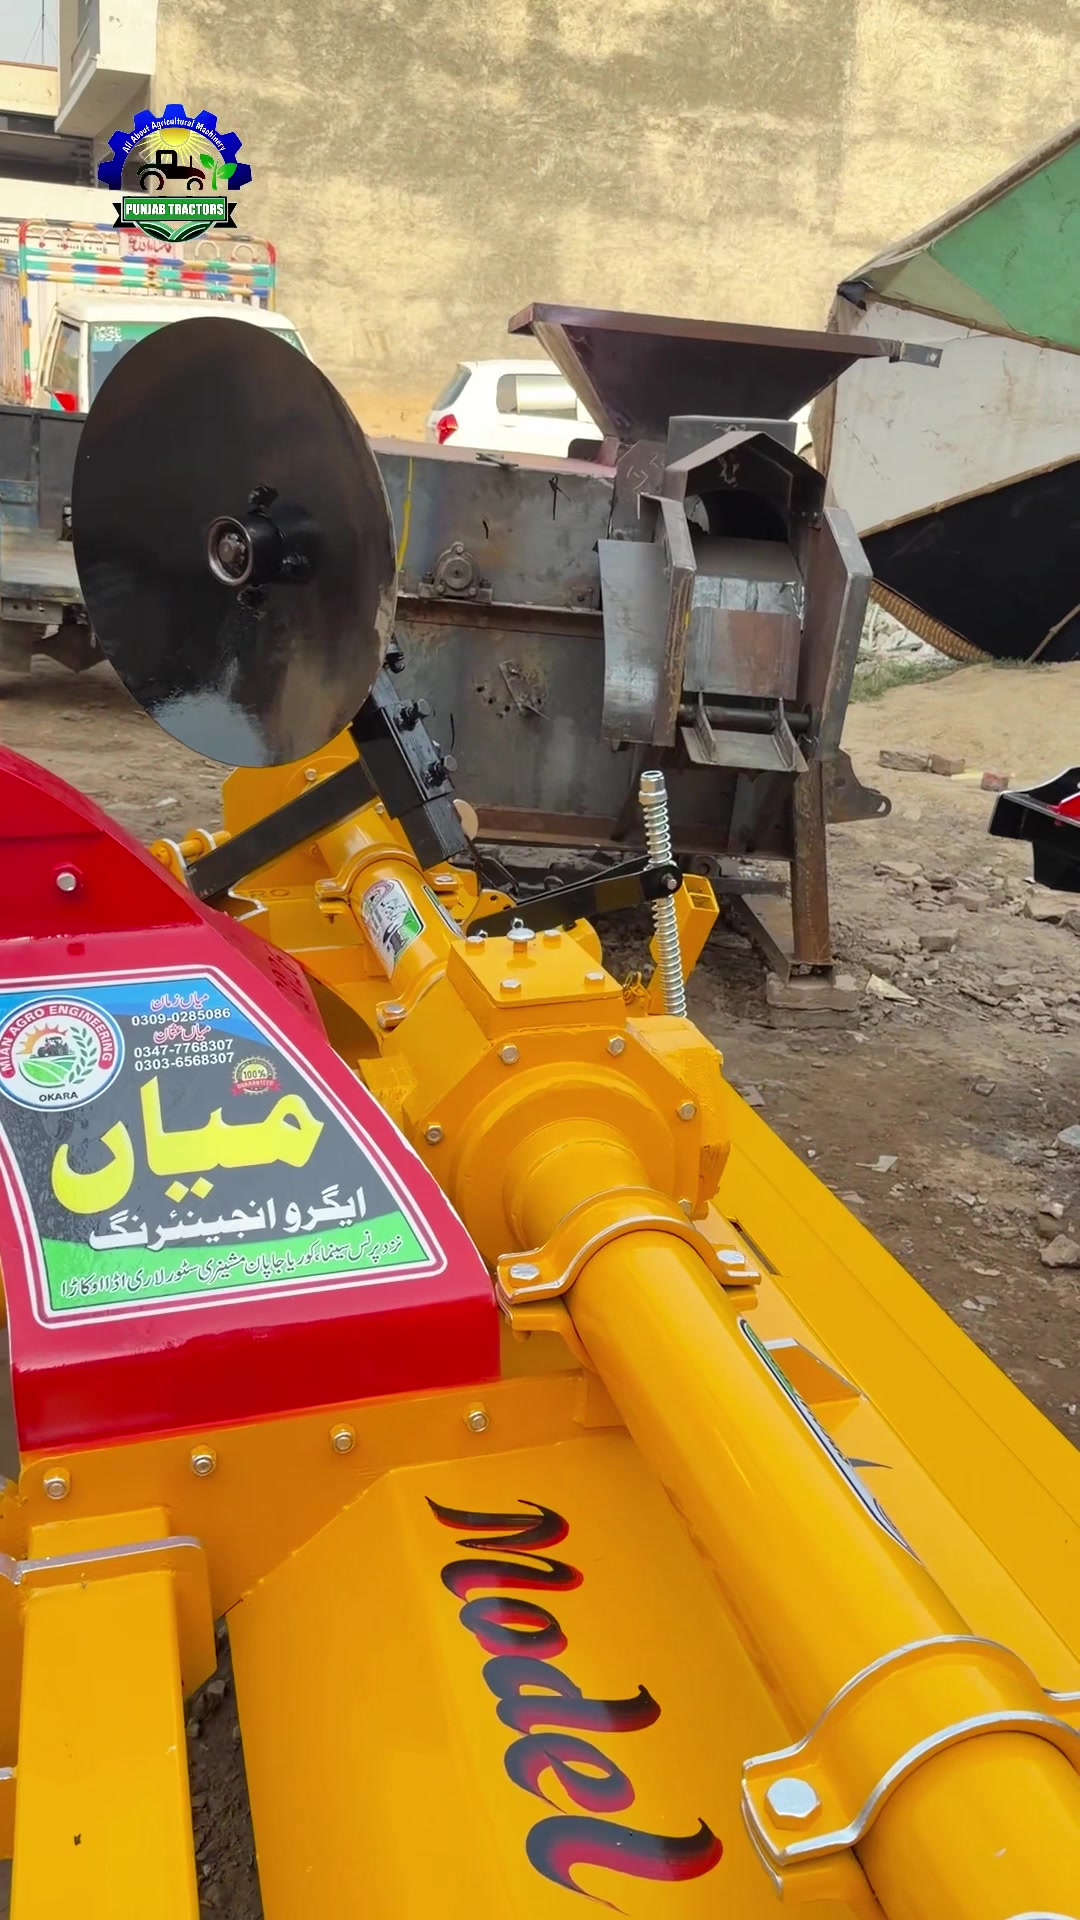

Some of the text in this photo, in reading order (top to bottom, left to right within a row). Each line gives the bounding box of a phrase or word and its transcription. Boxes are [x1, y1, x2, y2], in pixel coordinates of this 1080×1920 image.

[150, 991, 210, 1012] میاں زمان
[131, 1007, 231, 1026] 0309-0285086
[0, 1005, 113, 1072] MIAN AGRO ENGINEERING
[181, 1023, 212, 1042] میاں
[134, 1039, 234, 1058] 0347-7768307
[135, 1052, 235, 1072] 0303-6568307
[243, 1069, 267, 1079] 100%
[39, 1091, 79, 1102] OKARA
[52, 1075, 325, 1215] میاں
[88, 1184, 367, 1252] ایگرو انجینئرنگ
[382, 1235, 403, 1255] نزد
[197, 1252, 246, 1284] مشینری
[245, 1253, 284, 1279] جاپان
[424, 1495, 724, 1918] Model
